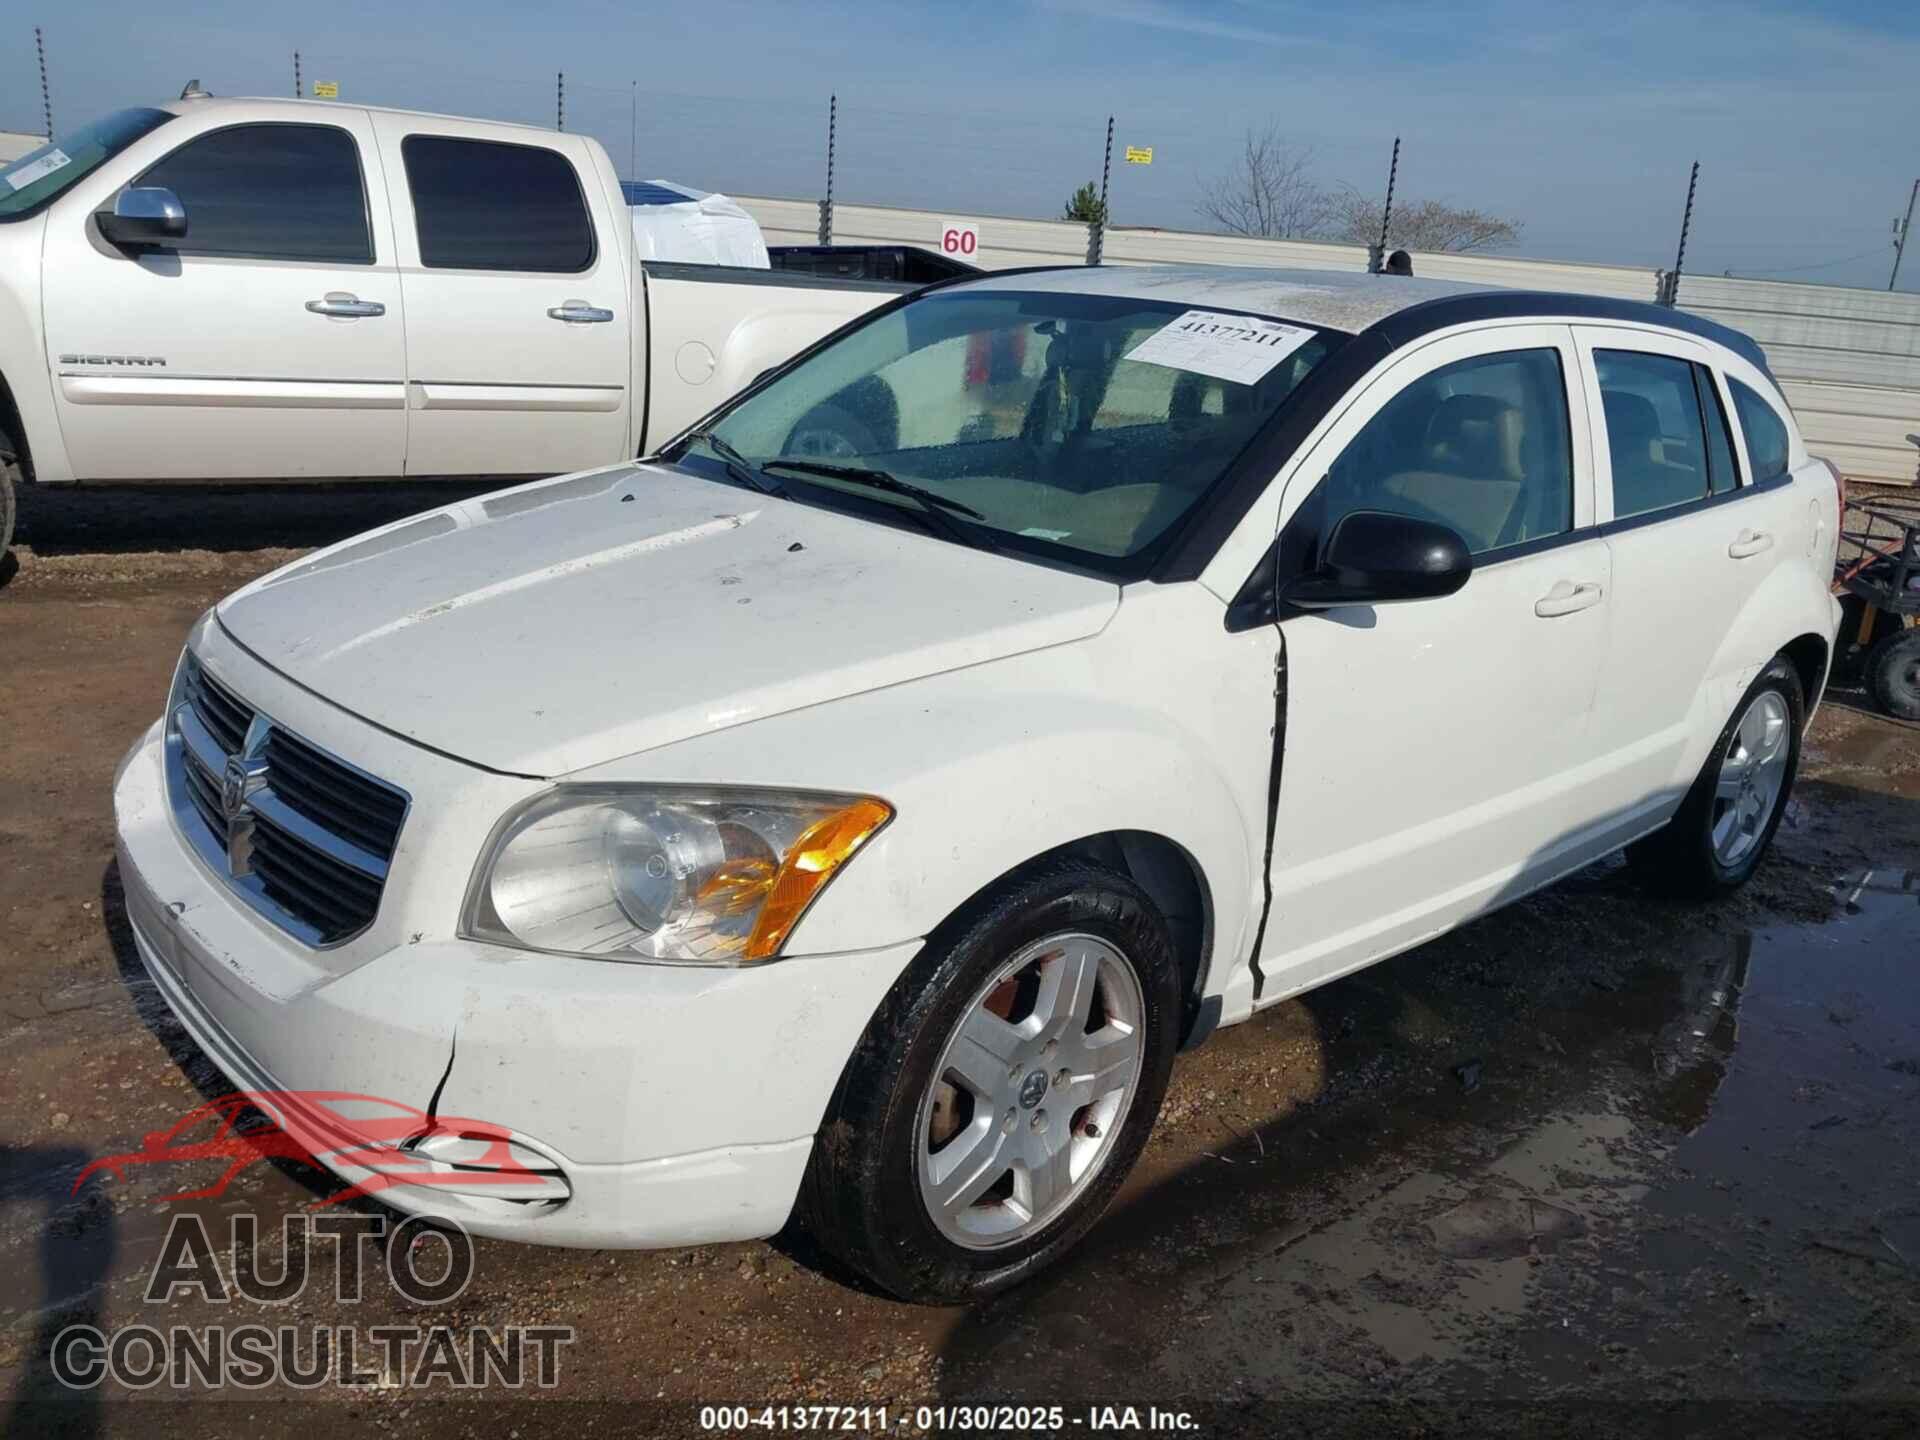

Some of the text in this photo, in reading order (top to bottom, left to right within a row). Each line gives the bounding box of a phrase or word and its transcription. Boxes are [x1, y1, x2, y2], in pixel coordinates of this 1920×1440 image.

[944, 229, 976, 255] 60
[1179, 321, 1283, 347] 41377211
[59, 354, 166, 366] SIERRA
